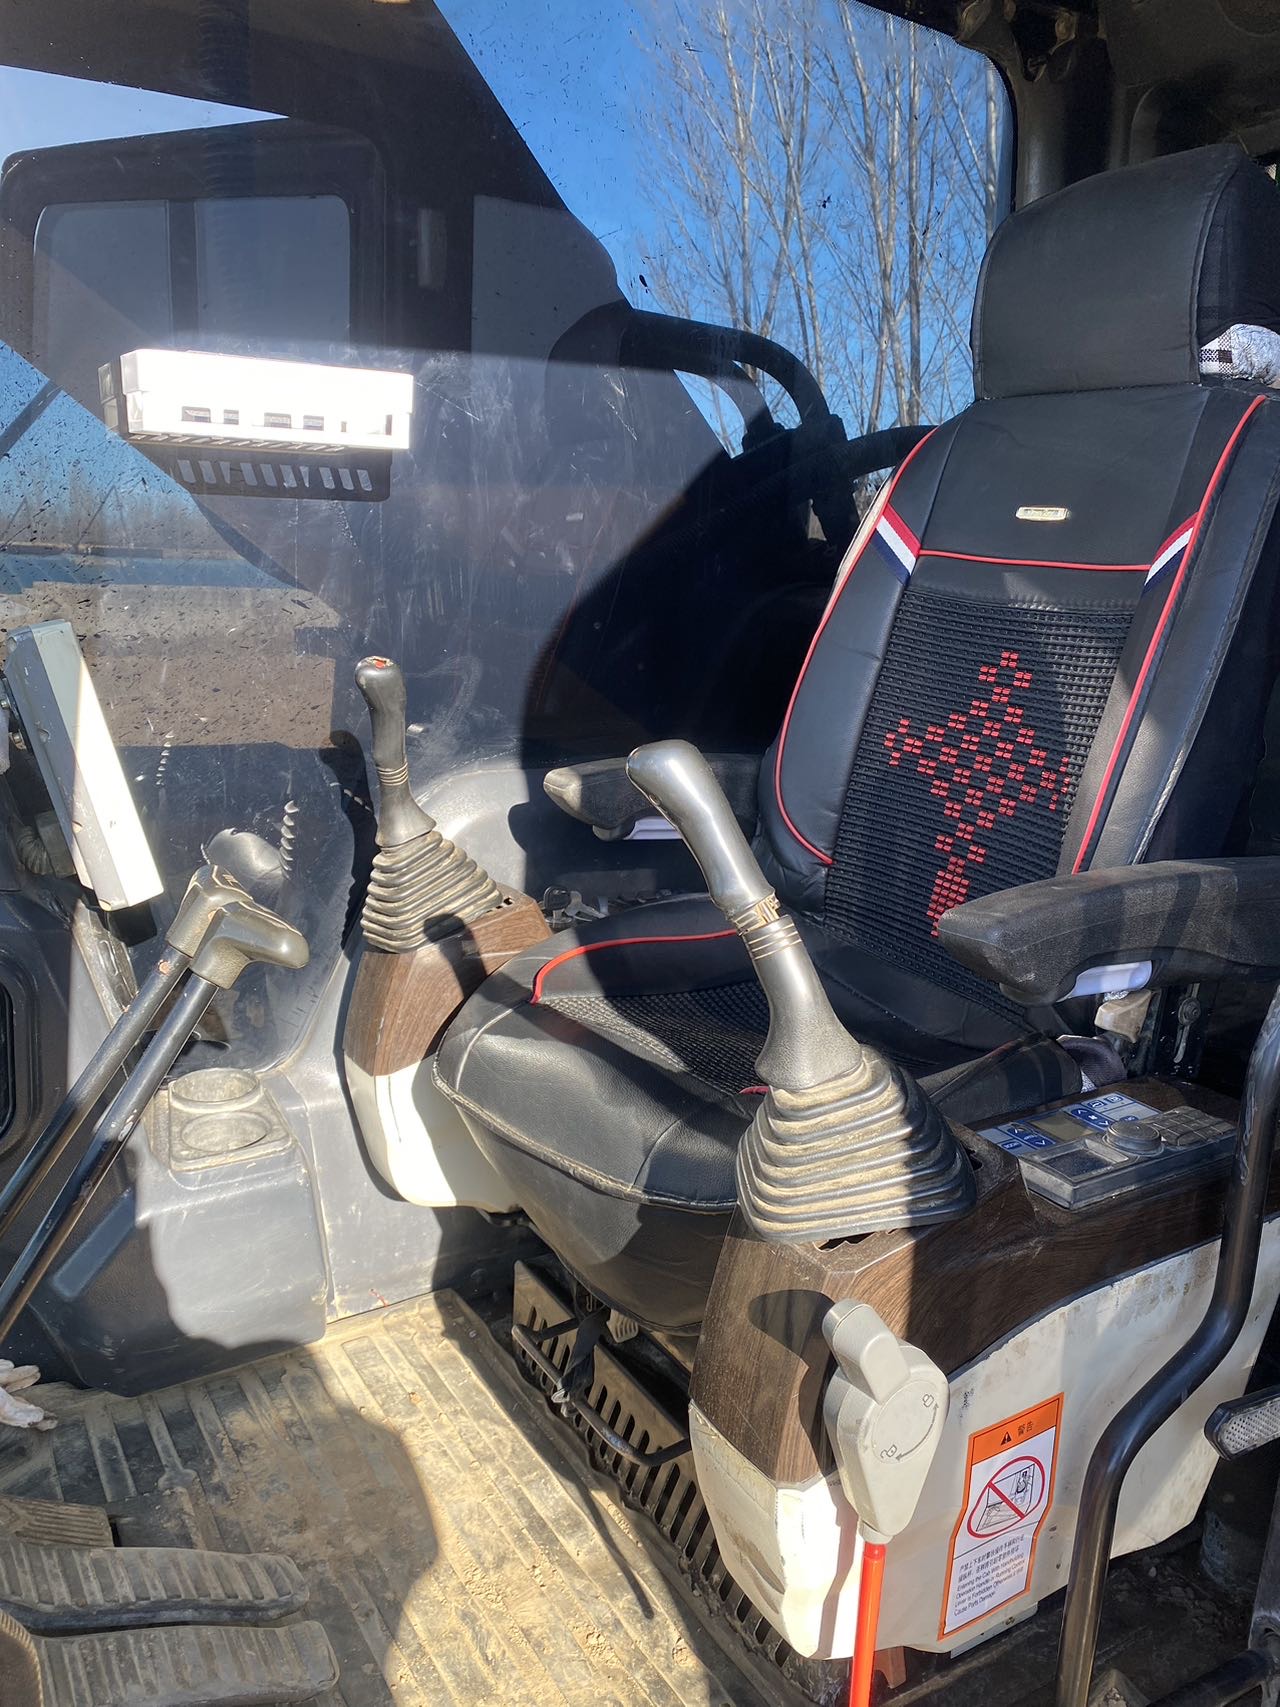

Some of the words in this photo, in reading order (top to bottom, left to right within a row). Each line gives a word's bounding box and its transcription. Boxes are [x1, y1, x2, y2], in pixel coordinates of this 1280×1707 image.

[1017, 1420, 1034, 1437] 警告
[956, 1586, 975, 1599] Operation
[976, 1579, 989, 1588] Handle
[995, 1567, 1011, 1579] Running
[1012, 1560, 1025, 1569] Control
[957, 1579, 975, 1591] Entering
[982, 1570, 991, 1578] Cab
[991, 1565, 1000, 1573] With
[1001, 1552, 1024, 1567] Handholding
[954, 1597, 967, 1608] Lever
[954, 1605, 968, 1617] Cause
[968, 1599, 979, 1609] Parts
